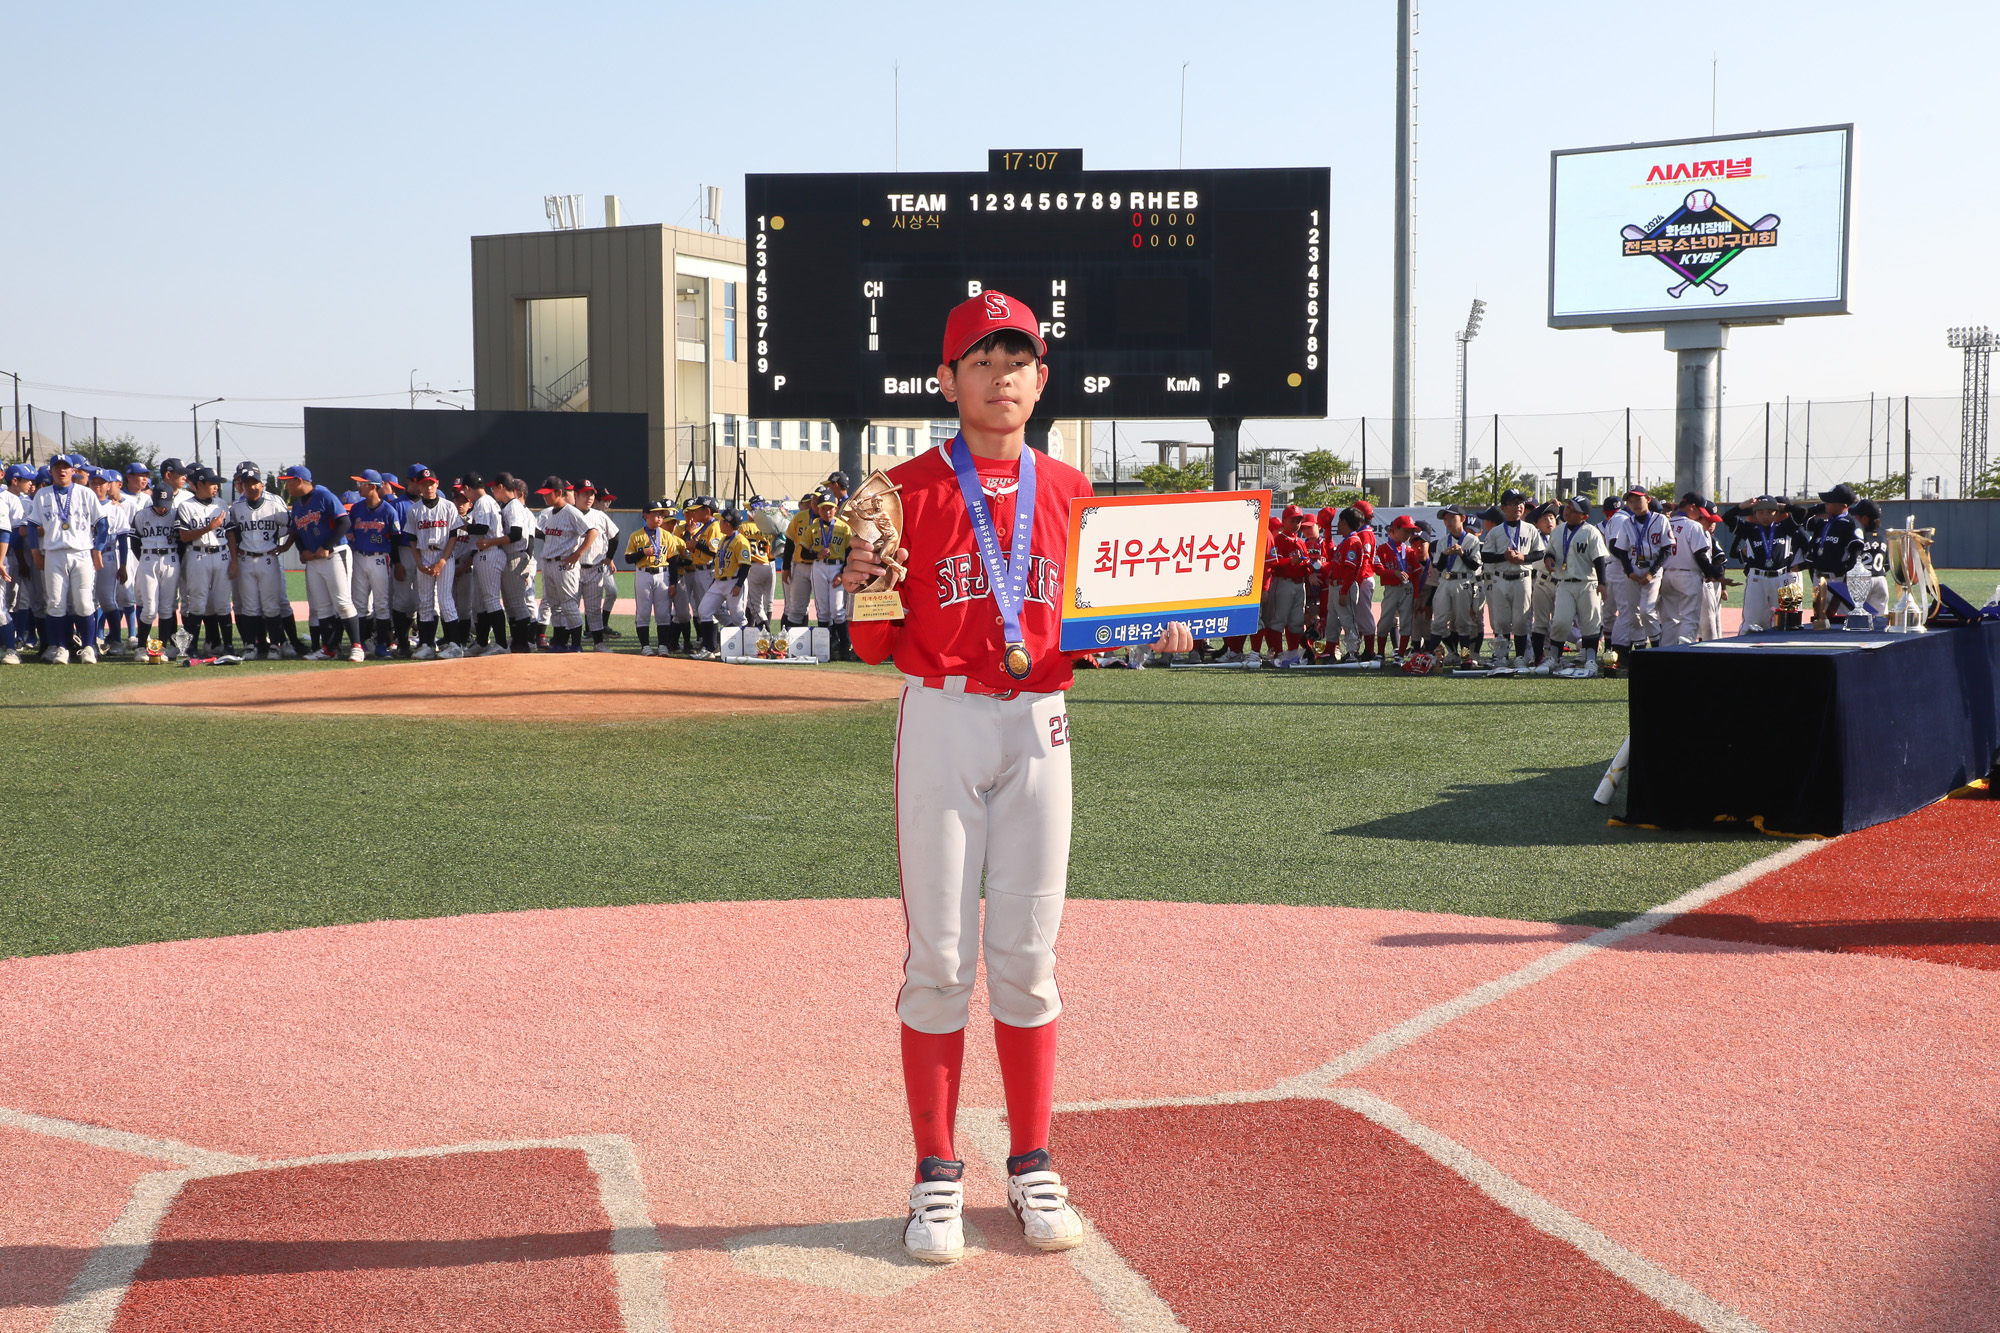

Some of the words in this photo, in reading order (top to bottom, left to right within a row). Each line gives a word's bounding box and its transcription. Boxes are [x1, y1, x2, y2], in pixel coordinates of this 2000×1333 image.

[1003, 152, 1059, 170] 17:07
[1646, 157, 1752, 182] 시사저널
[887, 194, 946, 211] TEAM
[757, 216, 765, 231] 1
[892, 214, 940, 230] 시상식
[1133, 213, 1142, 227] 0
[1151, 214, 1158, 226] 0
[1169, 214, 1176, 226] 0
[1187, 213, 1194, 225] 0
[1311, 210, 1318, 225] 1
[1644, 215, 1665, 231] 2024
[1309, 228, 1319, 244] 2
[1665, 221, 1732, 237] 화성시장배
[756, 234, 766, 249] 2
[1133, 234, 1142, 248] 0
[1151, 235, 1158, 247] 0
[1169, 235, 1176, 247] 0
[1187, 235, 1194, 247] 0
[1623, 230, 1776, 254] 전국유소년야구대회
[757, 251, 767, 267] 3
[1308, 246, 1319, 262] 3
[1679, 252, 1721, 265] KYBF
[756, 269, 767, 284] 4
[1308, 264, 1319, 280] 4
[757, 287, 767, 302] 5
[864, 281, 883, 297] CH
[1052, 280, 1066, 296] H
[1308, 283, 1318, 298] 5
[757, 305, 767, 320] 6
[985, 294, 1010, 320] S
[1053, 301, 1065, 317] E
[1308, 301, 1318, 316] 6
[757, 322, 768, 338] 7
[1307, 318, 1318, 334] 7
[758, 340, 768, 355] 8
[1307, 337, 1318, 352] 8
[758, 358, 768, 373] 9
[1307, 354, 1317, 370] 9
[774, 376, 786, 390] P
[885, 377, 922, 394] Ball
[1084, 377, 1111, 393] SP
[1167, 376, 1200, 392] Km/h
[1218, 373, 1230, 388] P
[239, 520, 276, 532] DAECHI
[417, 519, 448, 530] Giants
[1468, 516, 1476, 524] W
[263, 532, 270, 541] 3
[1520, 536, 1528, 547] W
[1094, 532, 1246, 578] 최우수선수상
[1576, 542, 1588, 554] W
[936, 552, 1060, 611] SEJNG
[1114, 616, 1228, 642] 대한유소야구연맹
